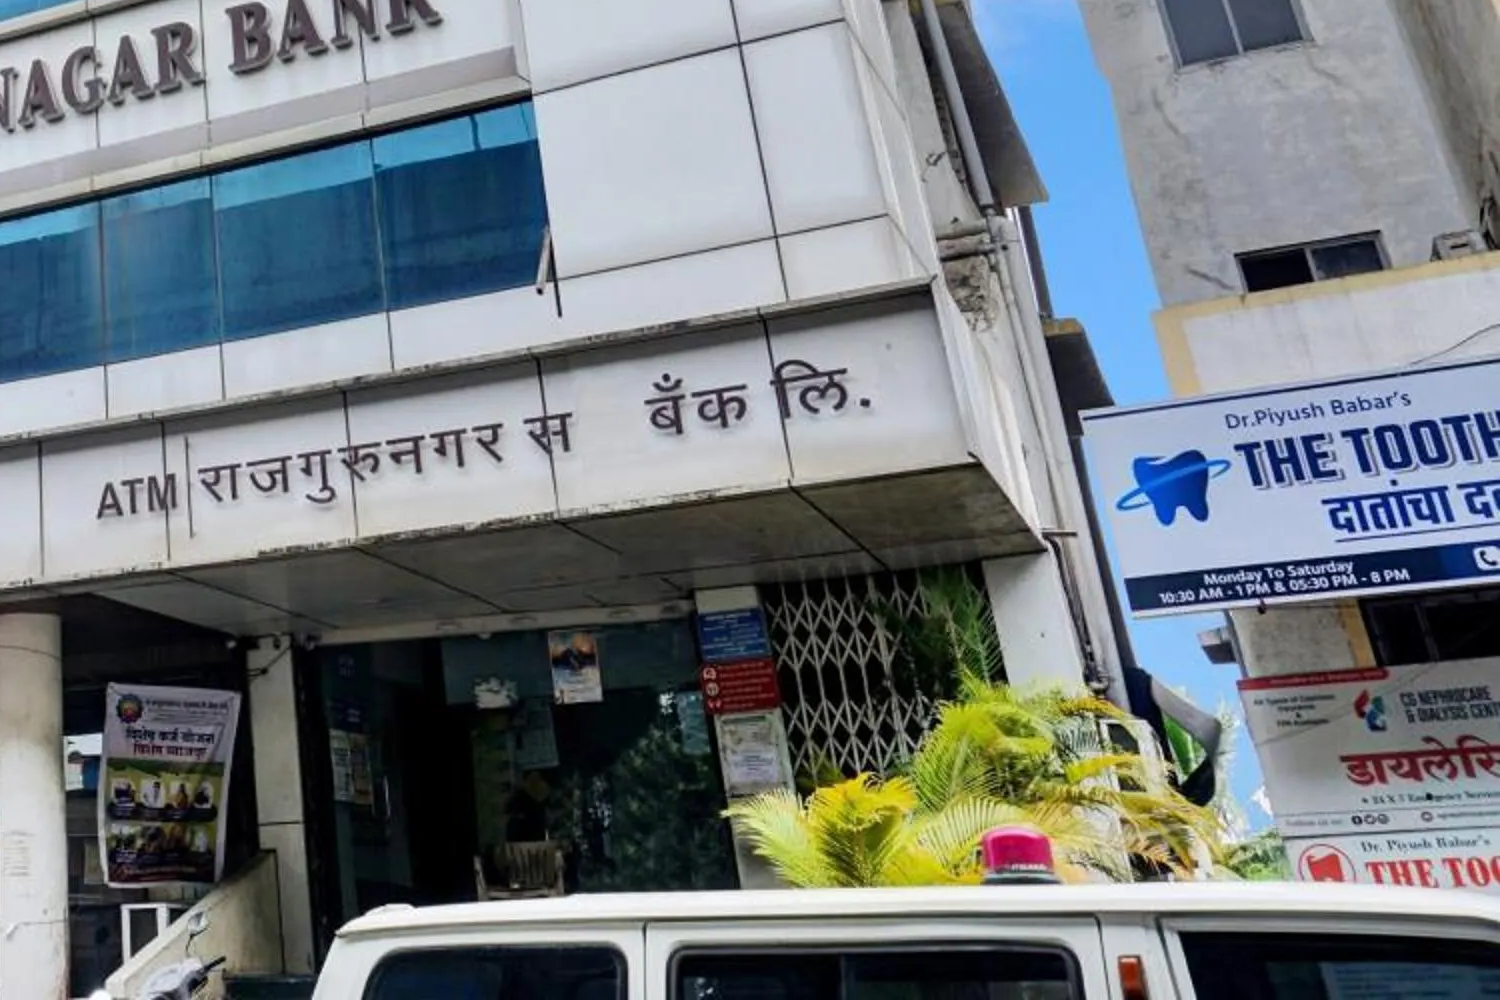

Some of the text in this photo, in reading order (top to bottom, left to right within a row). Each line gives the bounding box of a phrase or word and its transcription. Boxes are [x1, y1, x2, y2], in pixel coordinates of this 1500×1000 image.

[1233, 409, 1500, 490] THE TOOTH
[96, 472, 179, 520] ATM
[1320, 478, 1456, 535] दातांचा
[1159, 589, 1195, 604] 10:30
[1198, 586, 1224, 601] AM
[1245, 581, 1271, 597] PM
[1273, 580, 1286, 595] &
[1332, 572, 1359, 588] PM
[1383, 567, 1411, 583] PM
[1202, 559, 1354, 590] Monday To Saturday
[1364, 858, 1439, 889] THE
